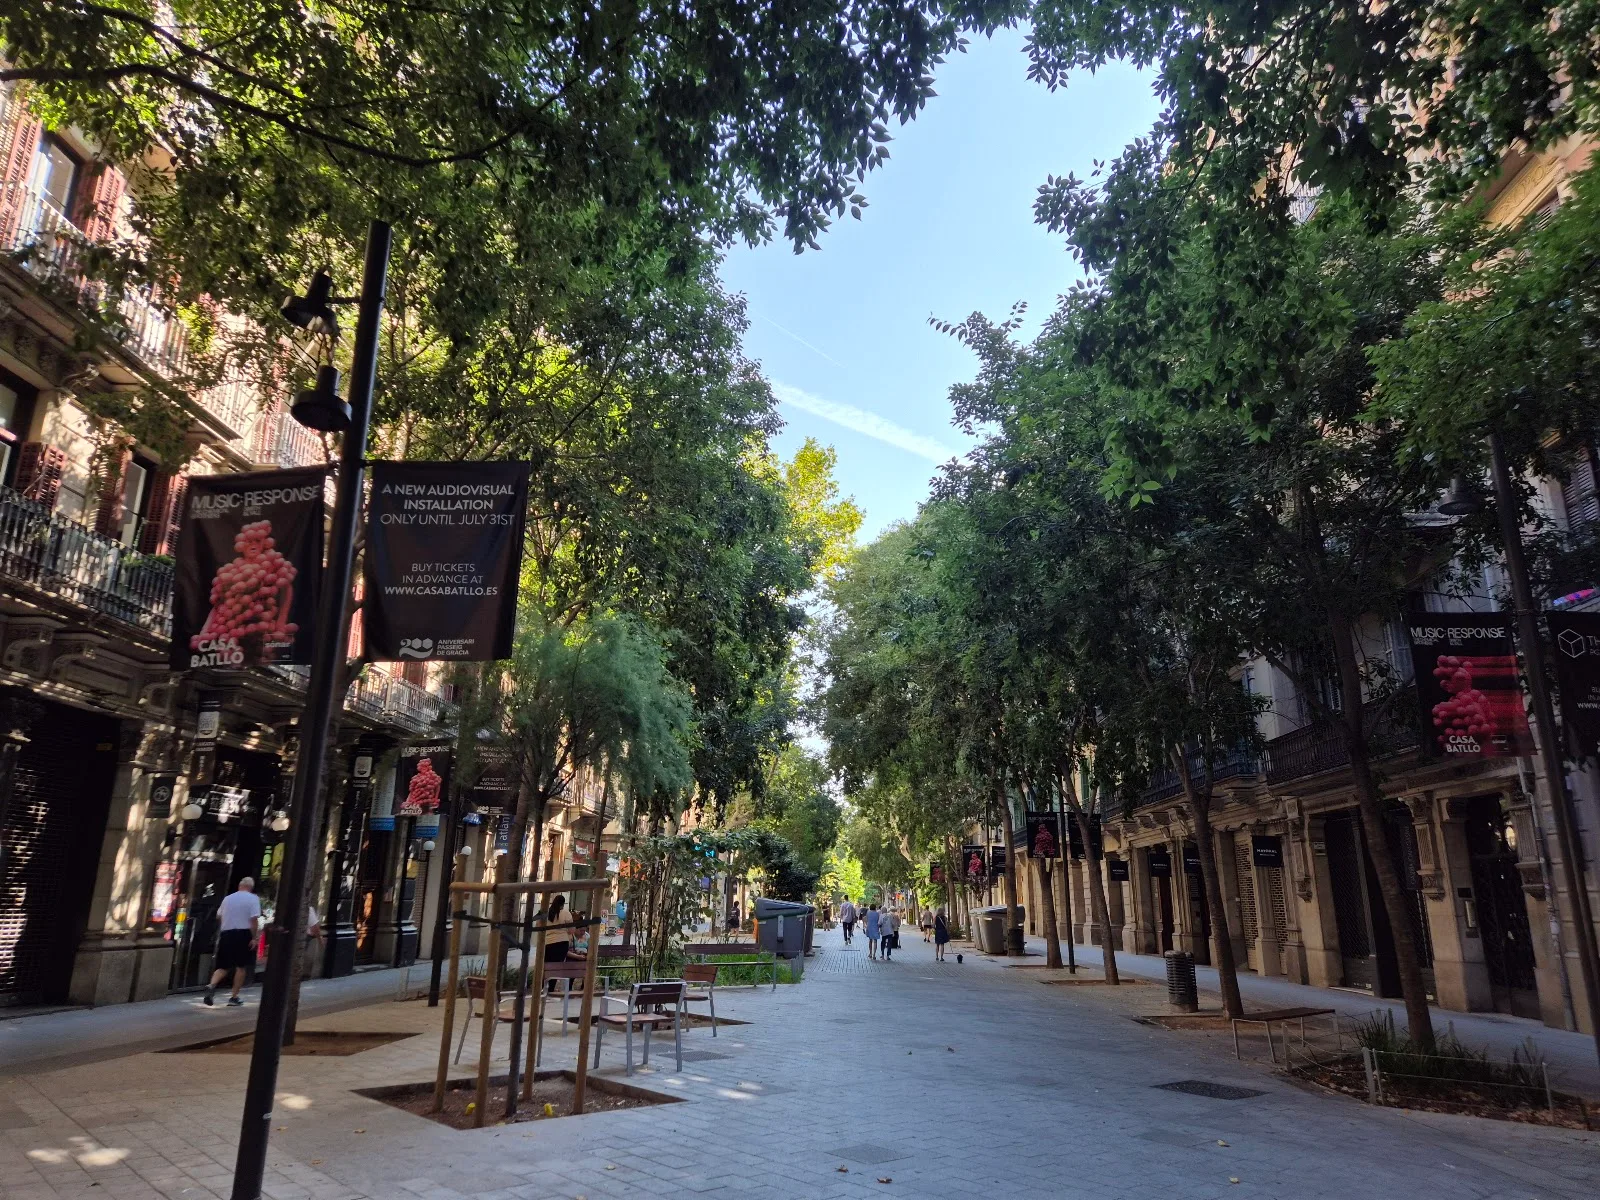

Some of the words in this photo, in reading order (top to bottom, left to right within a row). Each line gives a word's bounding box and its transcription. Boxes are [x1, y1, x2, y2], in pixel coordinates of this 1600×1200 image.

[381, 484, 392, 494] A
[394, 484, 426, 495] NEW
[427, 484, 515, 496] AUDIOVISUAL
[403, 499, 494, 511] INSTALLATION
[380, 513, 417, 525] ONLY
[418, 514, 456, 525] UNTIL
[458, 514, 489, 525] JULY
[489, 514, 515, 525] 31ST
[411, 563, 433, 572] BUY
[434, 563, 476, 573] TICKETS
[402, 574, 414, 584] IN
[415, 574, 469, 584] ADVANCE
[470, 575, 484, 584] AT
[384, 586, 498, 596] WWW.CASABATLLO.ES
[198, 637, 237, 652] CASA
[1448, 735, 1476, 744] CASA
